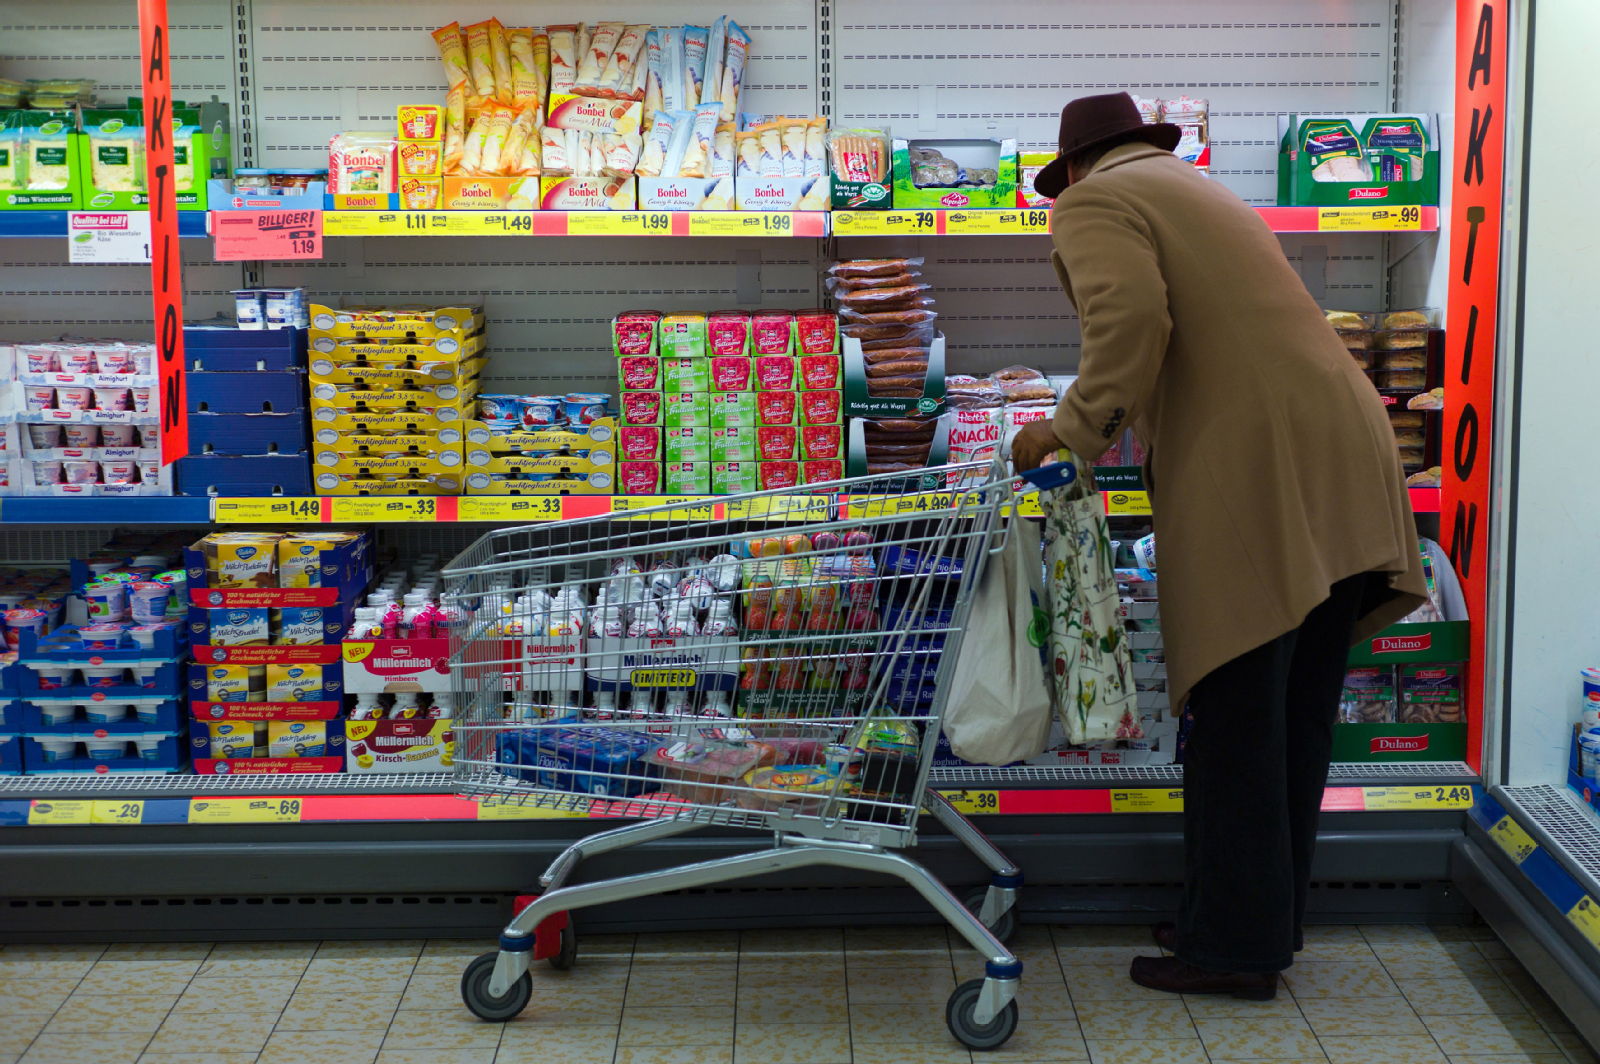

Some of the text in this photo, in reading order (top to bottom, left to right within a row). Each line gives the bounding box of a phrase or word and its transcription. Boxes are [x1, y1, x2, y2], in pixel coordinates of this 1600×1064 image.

[553, 96, 566, 107] NEU
[577, 106, 606, 117] Bonbel
[343, 154, 386, 166] Bonbel
[462, 188, 492, 197] Bonbel
[569, 188, 598, 197] Bonbel
[658, 188, 687, 197] Bonbel
[755, 188, 785, 197] Bonbel
[1355, 188, 1381, 197] Dulano
[32, 195, 72, 203] Wiesentaler
[176, 195, 197, 203] ntaler
[346, 197, 377, 206] Bonbel
[258, 211, 315, 228] BILLIGER!
[904, 212, 935, 228] -.79
[1020, 211, 1047, 226] 1.69
[1391, 207, 1419, 222] -.99
[405, 214, 426, 229] 1.11
[502, 215, 532, 230] 1.49
[641, 215, 669, 229] 1.99
[763, 215, 790, 230] 1.99
[149, 24, 181, 434] AKTION
[292, 240, 315, 254] 1.19
[1451, 3, 1494, 580] AKTION
[98, 375, 128, 384] Almighurt
[95, 412, 125, 420] Almighurt
[957, 411, 986, 423] Herta
[105, 449, 135, 457] Almighurt
[104, 486, 135, 494] Almighurt
[289, 500, 320, 516] 1.49
[405, 499, 436, 515] -.33
[531, 498, 561, 513] -.33
[1381, 638, 1421, 650] Dulano
[348, 647, 365, 658] NEU
[373, 657, 432, 668] Müllermilch
[351, 725, 368, 736] NEU
[375, 736, 434, 747] Müllermilch
[1380, 739, 1419, 750] Dulano
[376, 748, 440, 763] Kirsch-Banane
[933, 755, 962, 767] joghurt
[1102, 757, 1120, 765] Reis
[1435, 787, 1470, 802] 2.49
[965, 793, 997, 809] -.39
[109, 803, 140, 818] -.29
[267, 800, 300, 815] -.69
